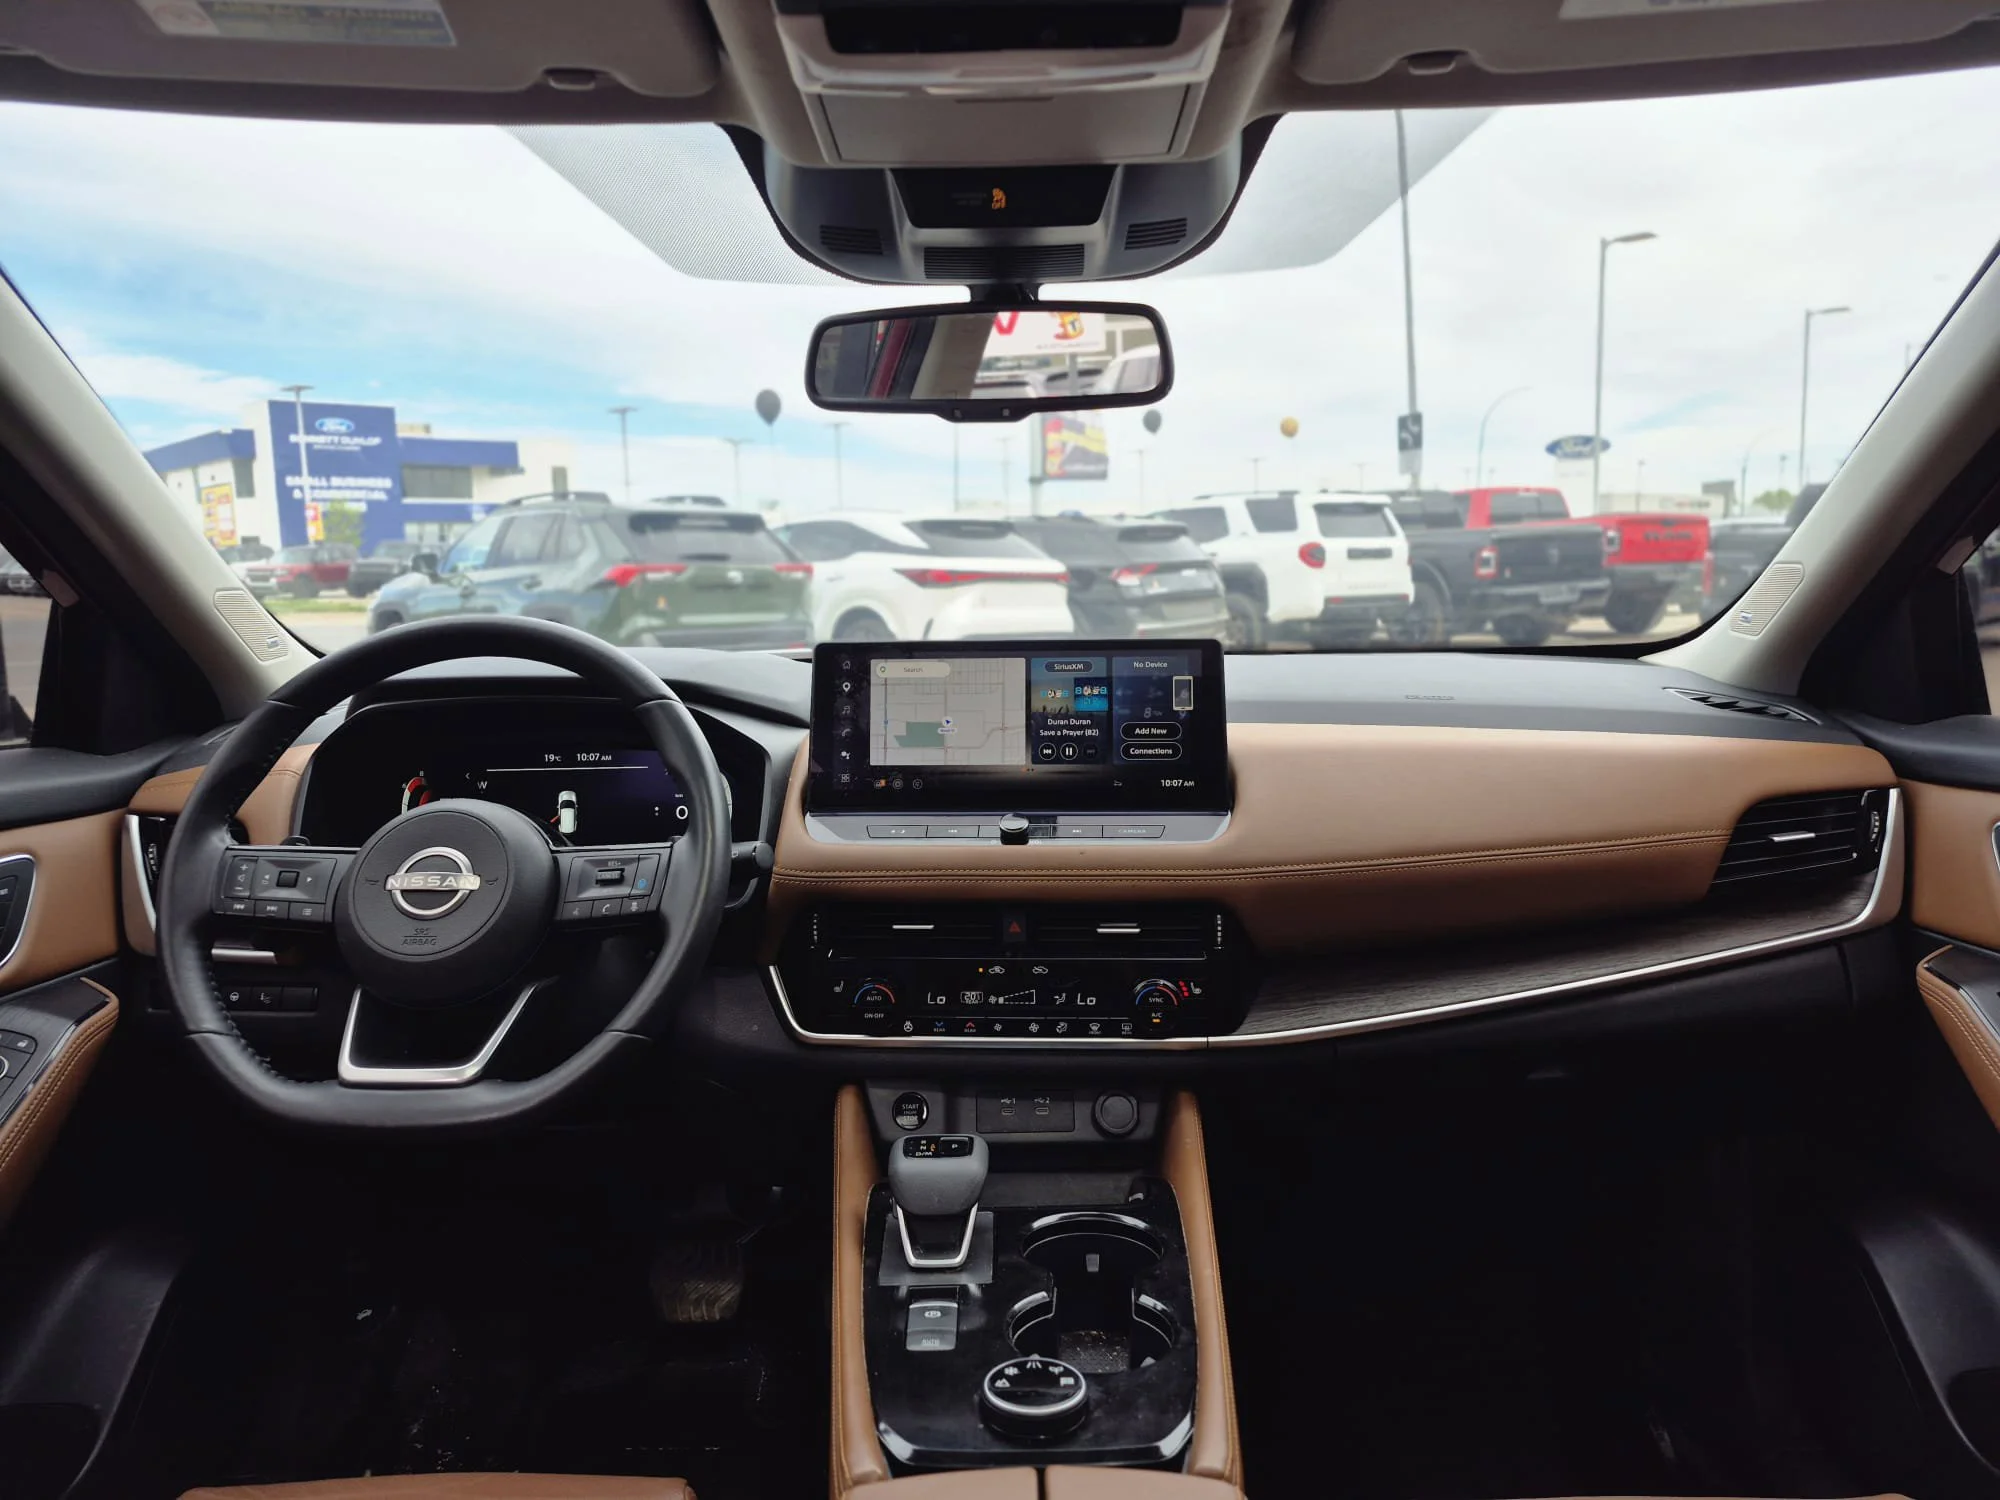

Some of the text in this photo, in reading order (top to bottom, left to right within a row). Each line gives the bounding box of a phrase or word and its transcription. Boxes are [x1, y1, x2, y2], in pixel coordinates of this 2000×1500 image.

[1047, 718, 1091, 726] Duran Duran
[1062, 729, 1084, 737] Prayer
[576, 753, 600, 762] 10:07
[477, 781, 488, 790] W
[1160, 779, 1182, 787] 10:07
[388, 875, 479, 889] NISSAN
[401, 938, 437, 946] AIRBAG
[927, 991, 946, 1004] Lo
[1077, 993, 1097, 1005] Lo
